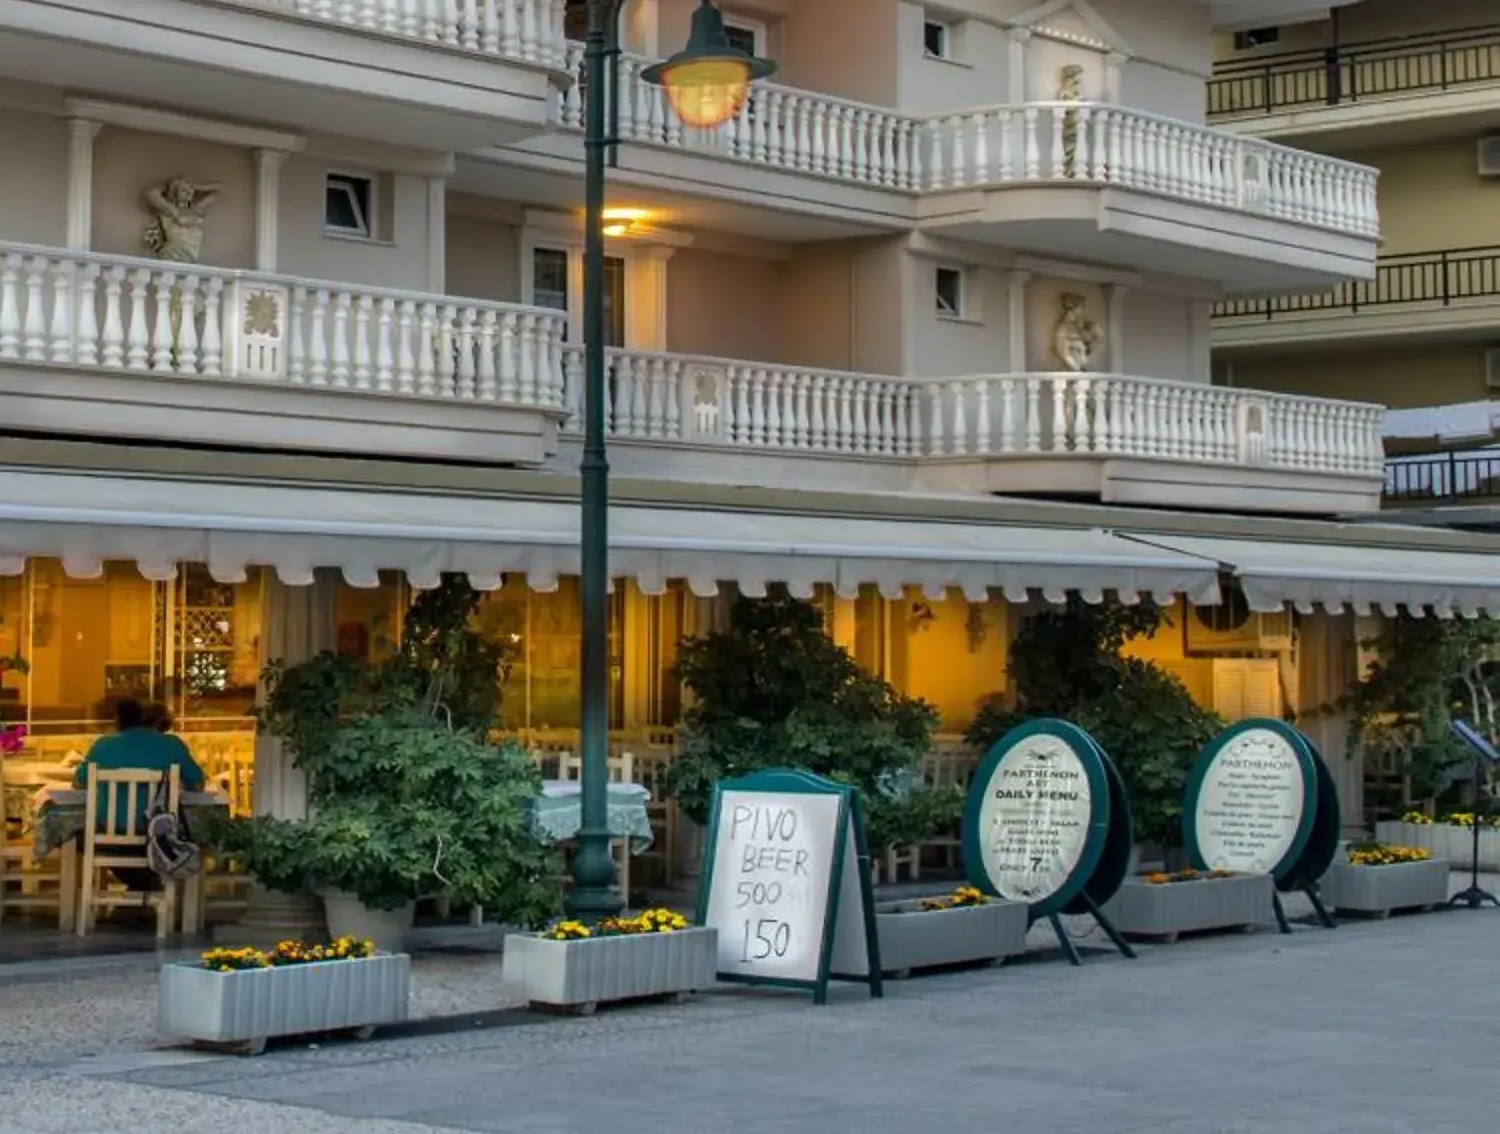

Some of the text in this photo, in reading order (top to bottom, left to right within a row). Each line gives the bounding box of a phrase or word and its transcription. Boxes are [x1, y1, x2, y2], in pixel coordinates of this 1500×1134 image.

[995, 789, 1079, 801] DAILY MENU
[730, 804, 798, 842] PIVO
[741, 843, 810, 877] BEER
[1029, 857, 1043, 872] 7
[734, 880, 783, 909] 500
